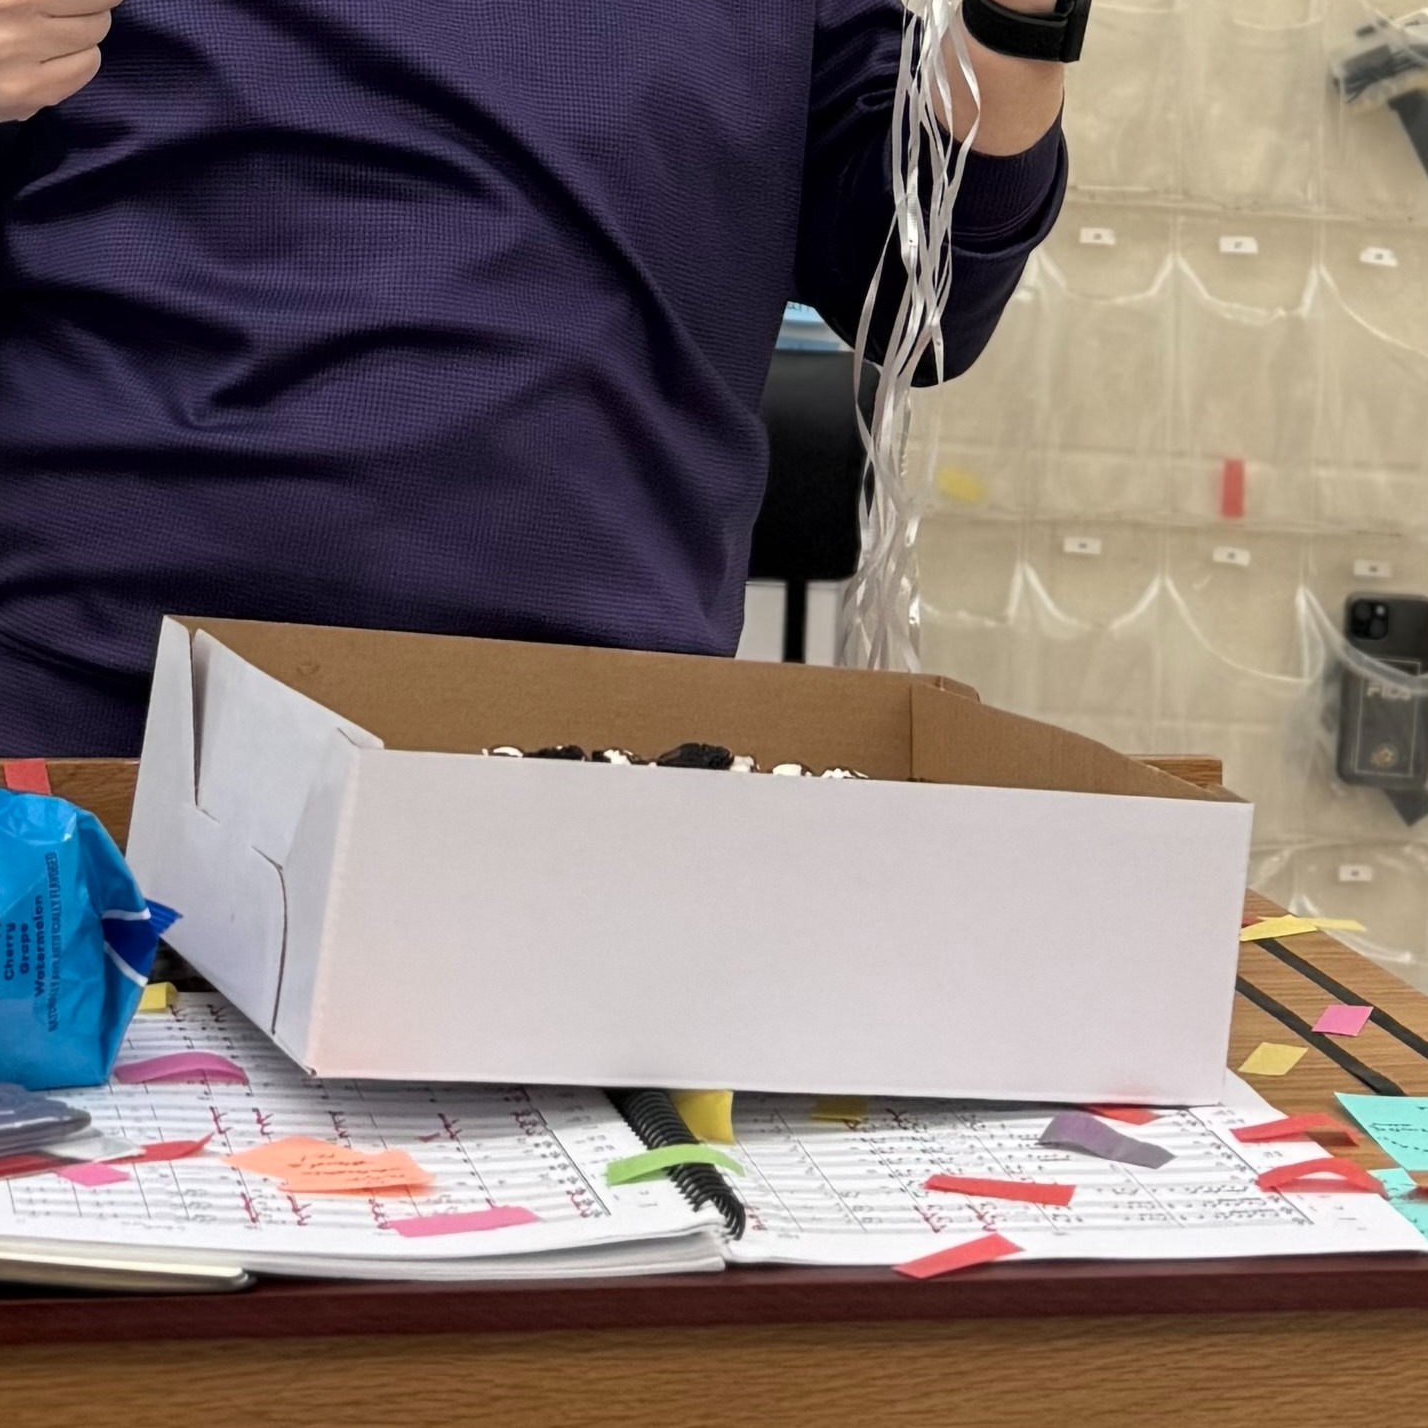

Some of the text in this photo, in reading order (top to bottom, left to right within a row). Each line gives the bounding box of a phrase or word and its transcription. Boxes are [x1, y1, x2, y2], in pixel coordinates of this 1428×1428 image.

[3, 922, 16, 980] Cherry
[19, 922, 30, 974] Grape
[33, 896, 46, 997] Watermelon
